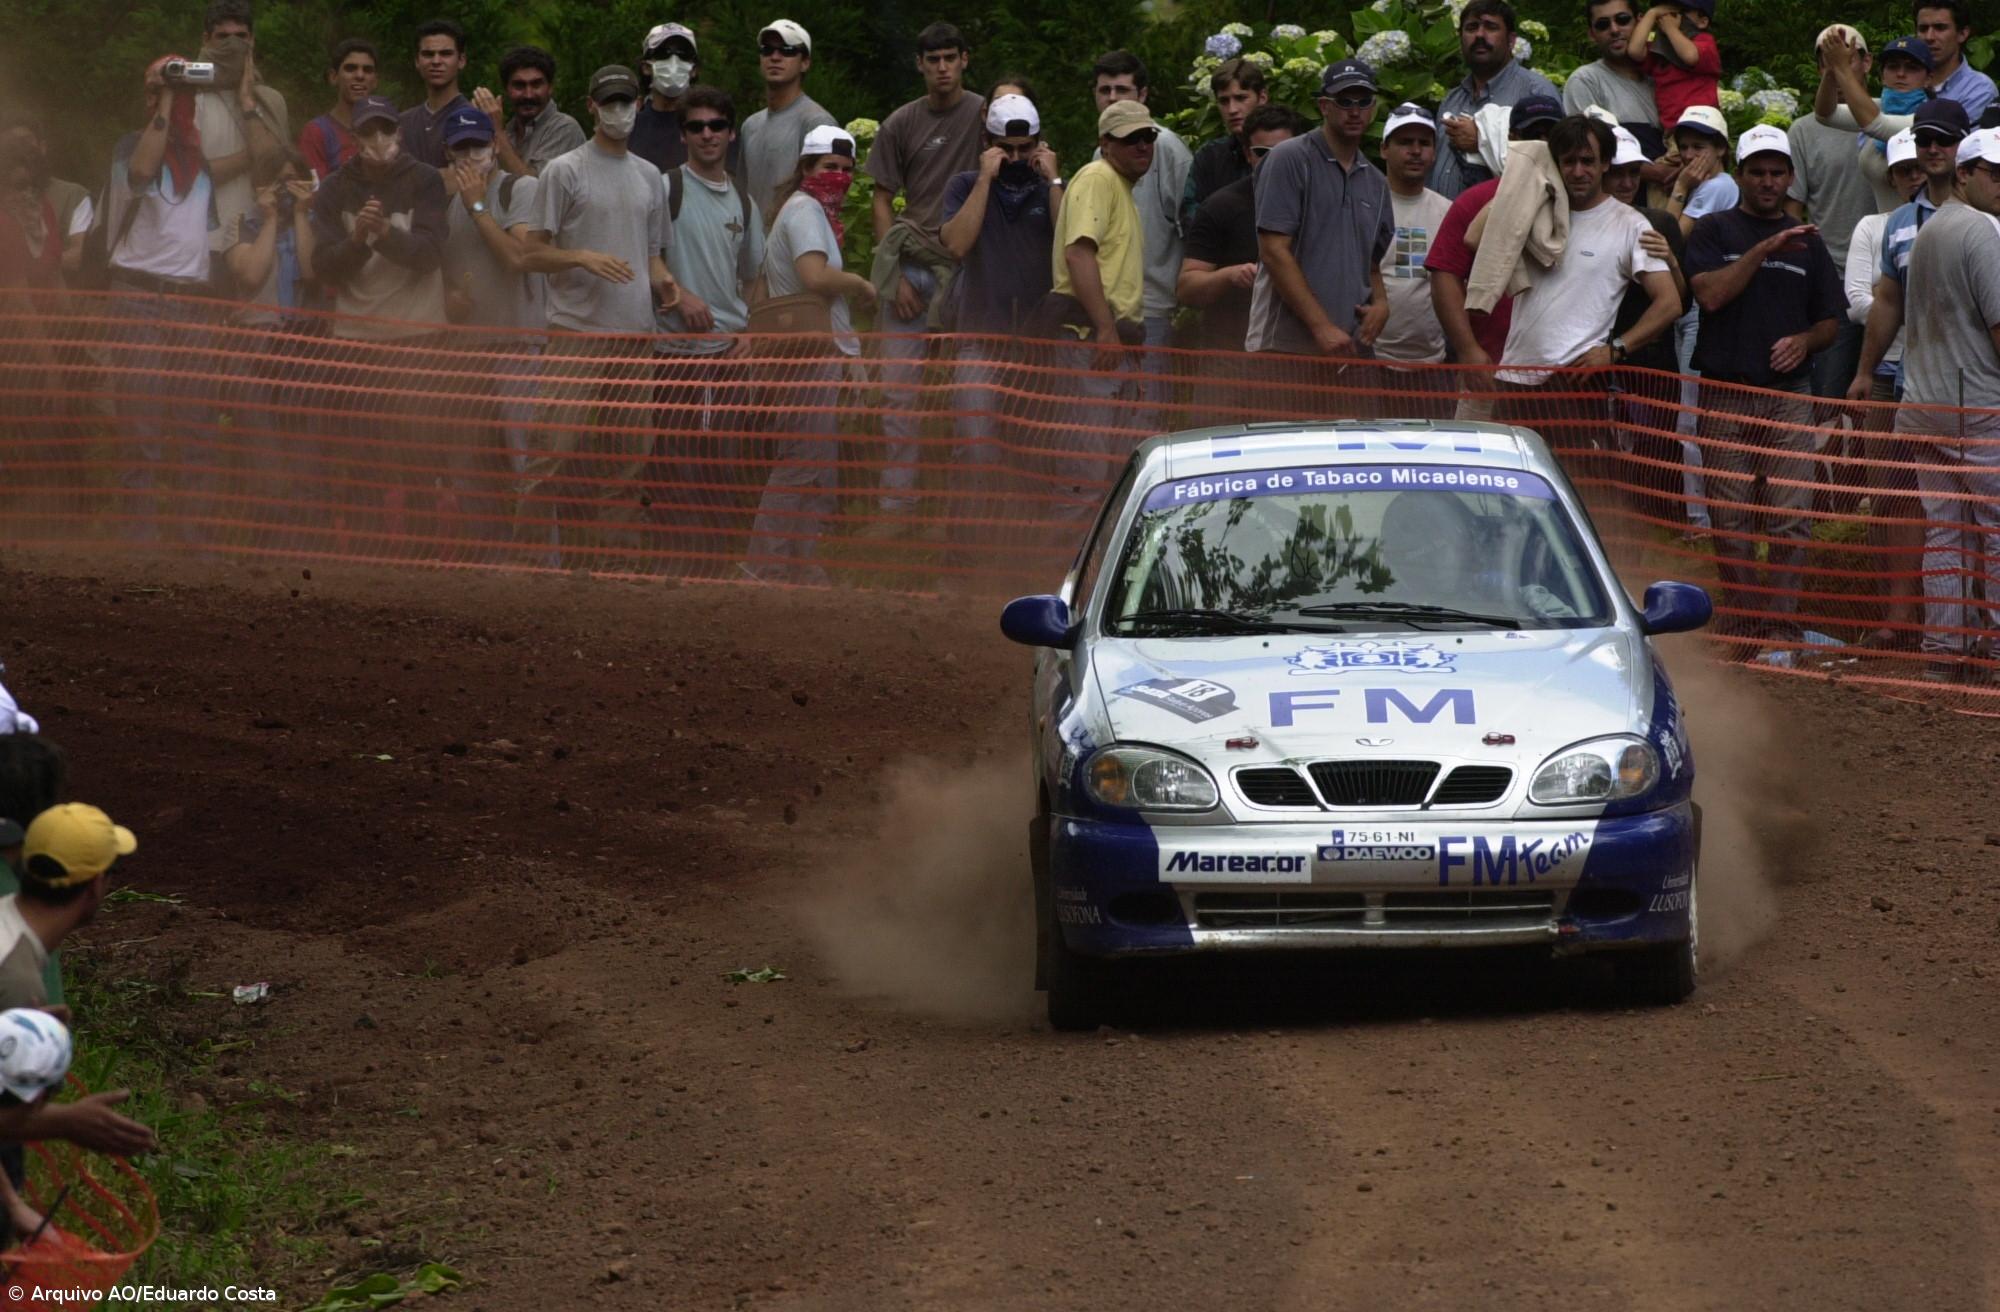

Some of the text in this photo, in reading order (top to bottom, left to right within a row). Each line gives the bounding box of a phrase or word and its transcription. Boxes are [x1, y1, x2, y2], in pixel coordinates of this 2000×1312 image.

[1174, 468, 1519, 500] Fábrica de Tabaco Micaelense
[1165, 851, 1306, 873] Mareacor
[1343, 847, 1432, 860] DAEWOO
[1438, 835, 1518, 886] FM
